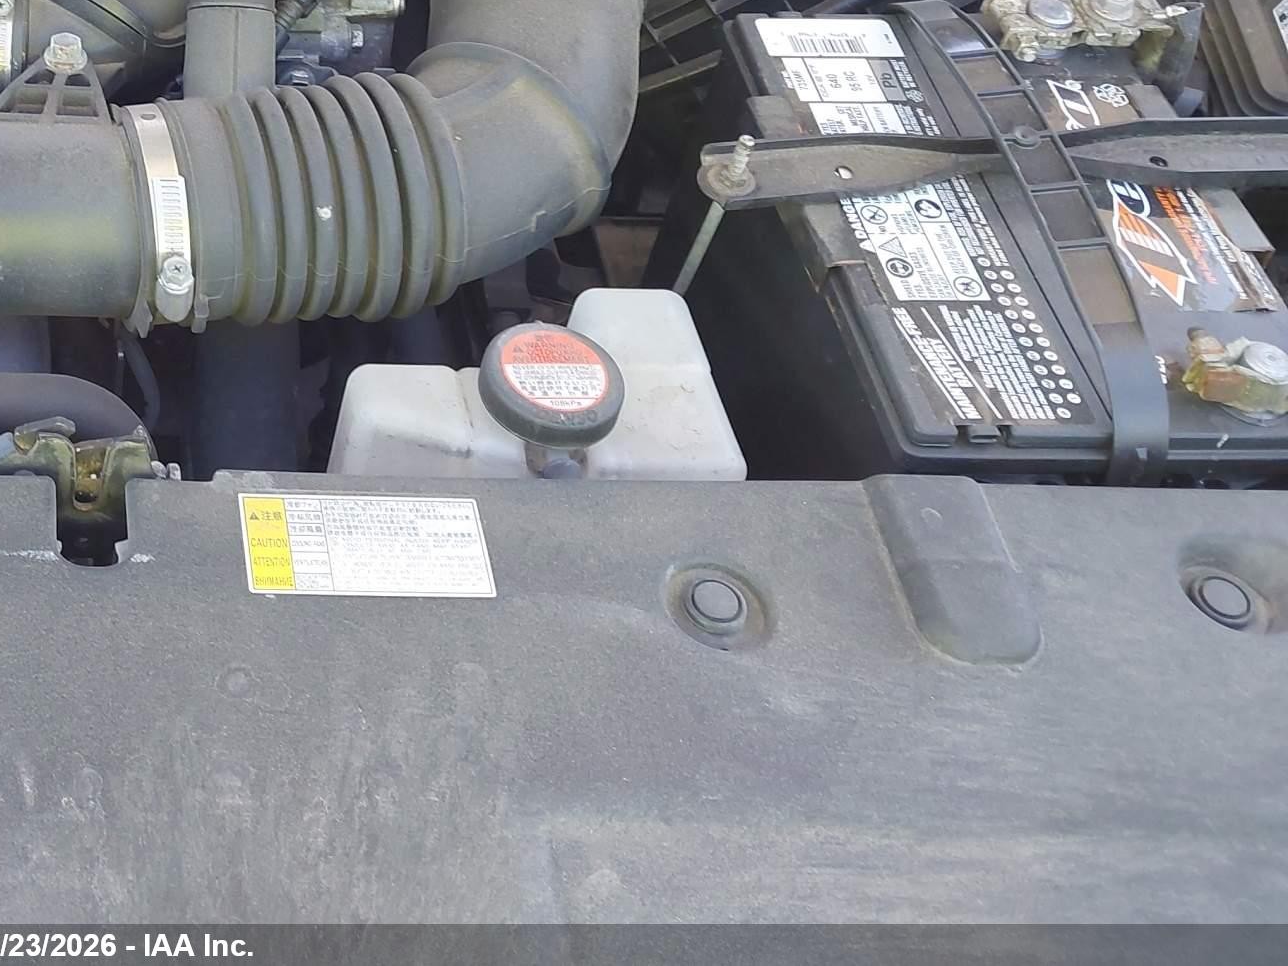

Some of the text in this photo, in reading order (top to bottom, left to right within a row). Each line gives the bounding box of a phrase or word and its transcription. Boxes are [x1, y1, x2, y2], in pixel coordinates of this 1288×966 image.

[880, 72, 897, 89] Pb
[839, 197, 868, 239] DANGE
[890, 306, 983, 418] MAINTENANCE-FREE
[926, 337, 974, 387] BATTERY
[261, 510, 283, 522] 注意
[251, 537, 289, 549] CAUTION
[253, 556, 292, 568] ATTENTION
